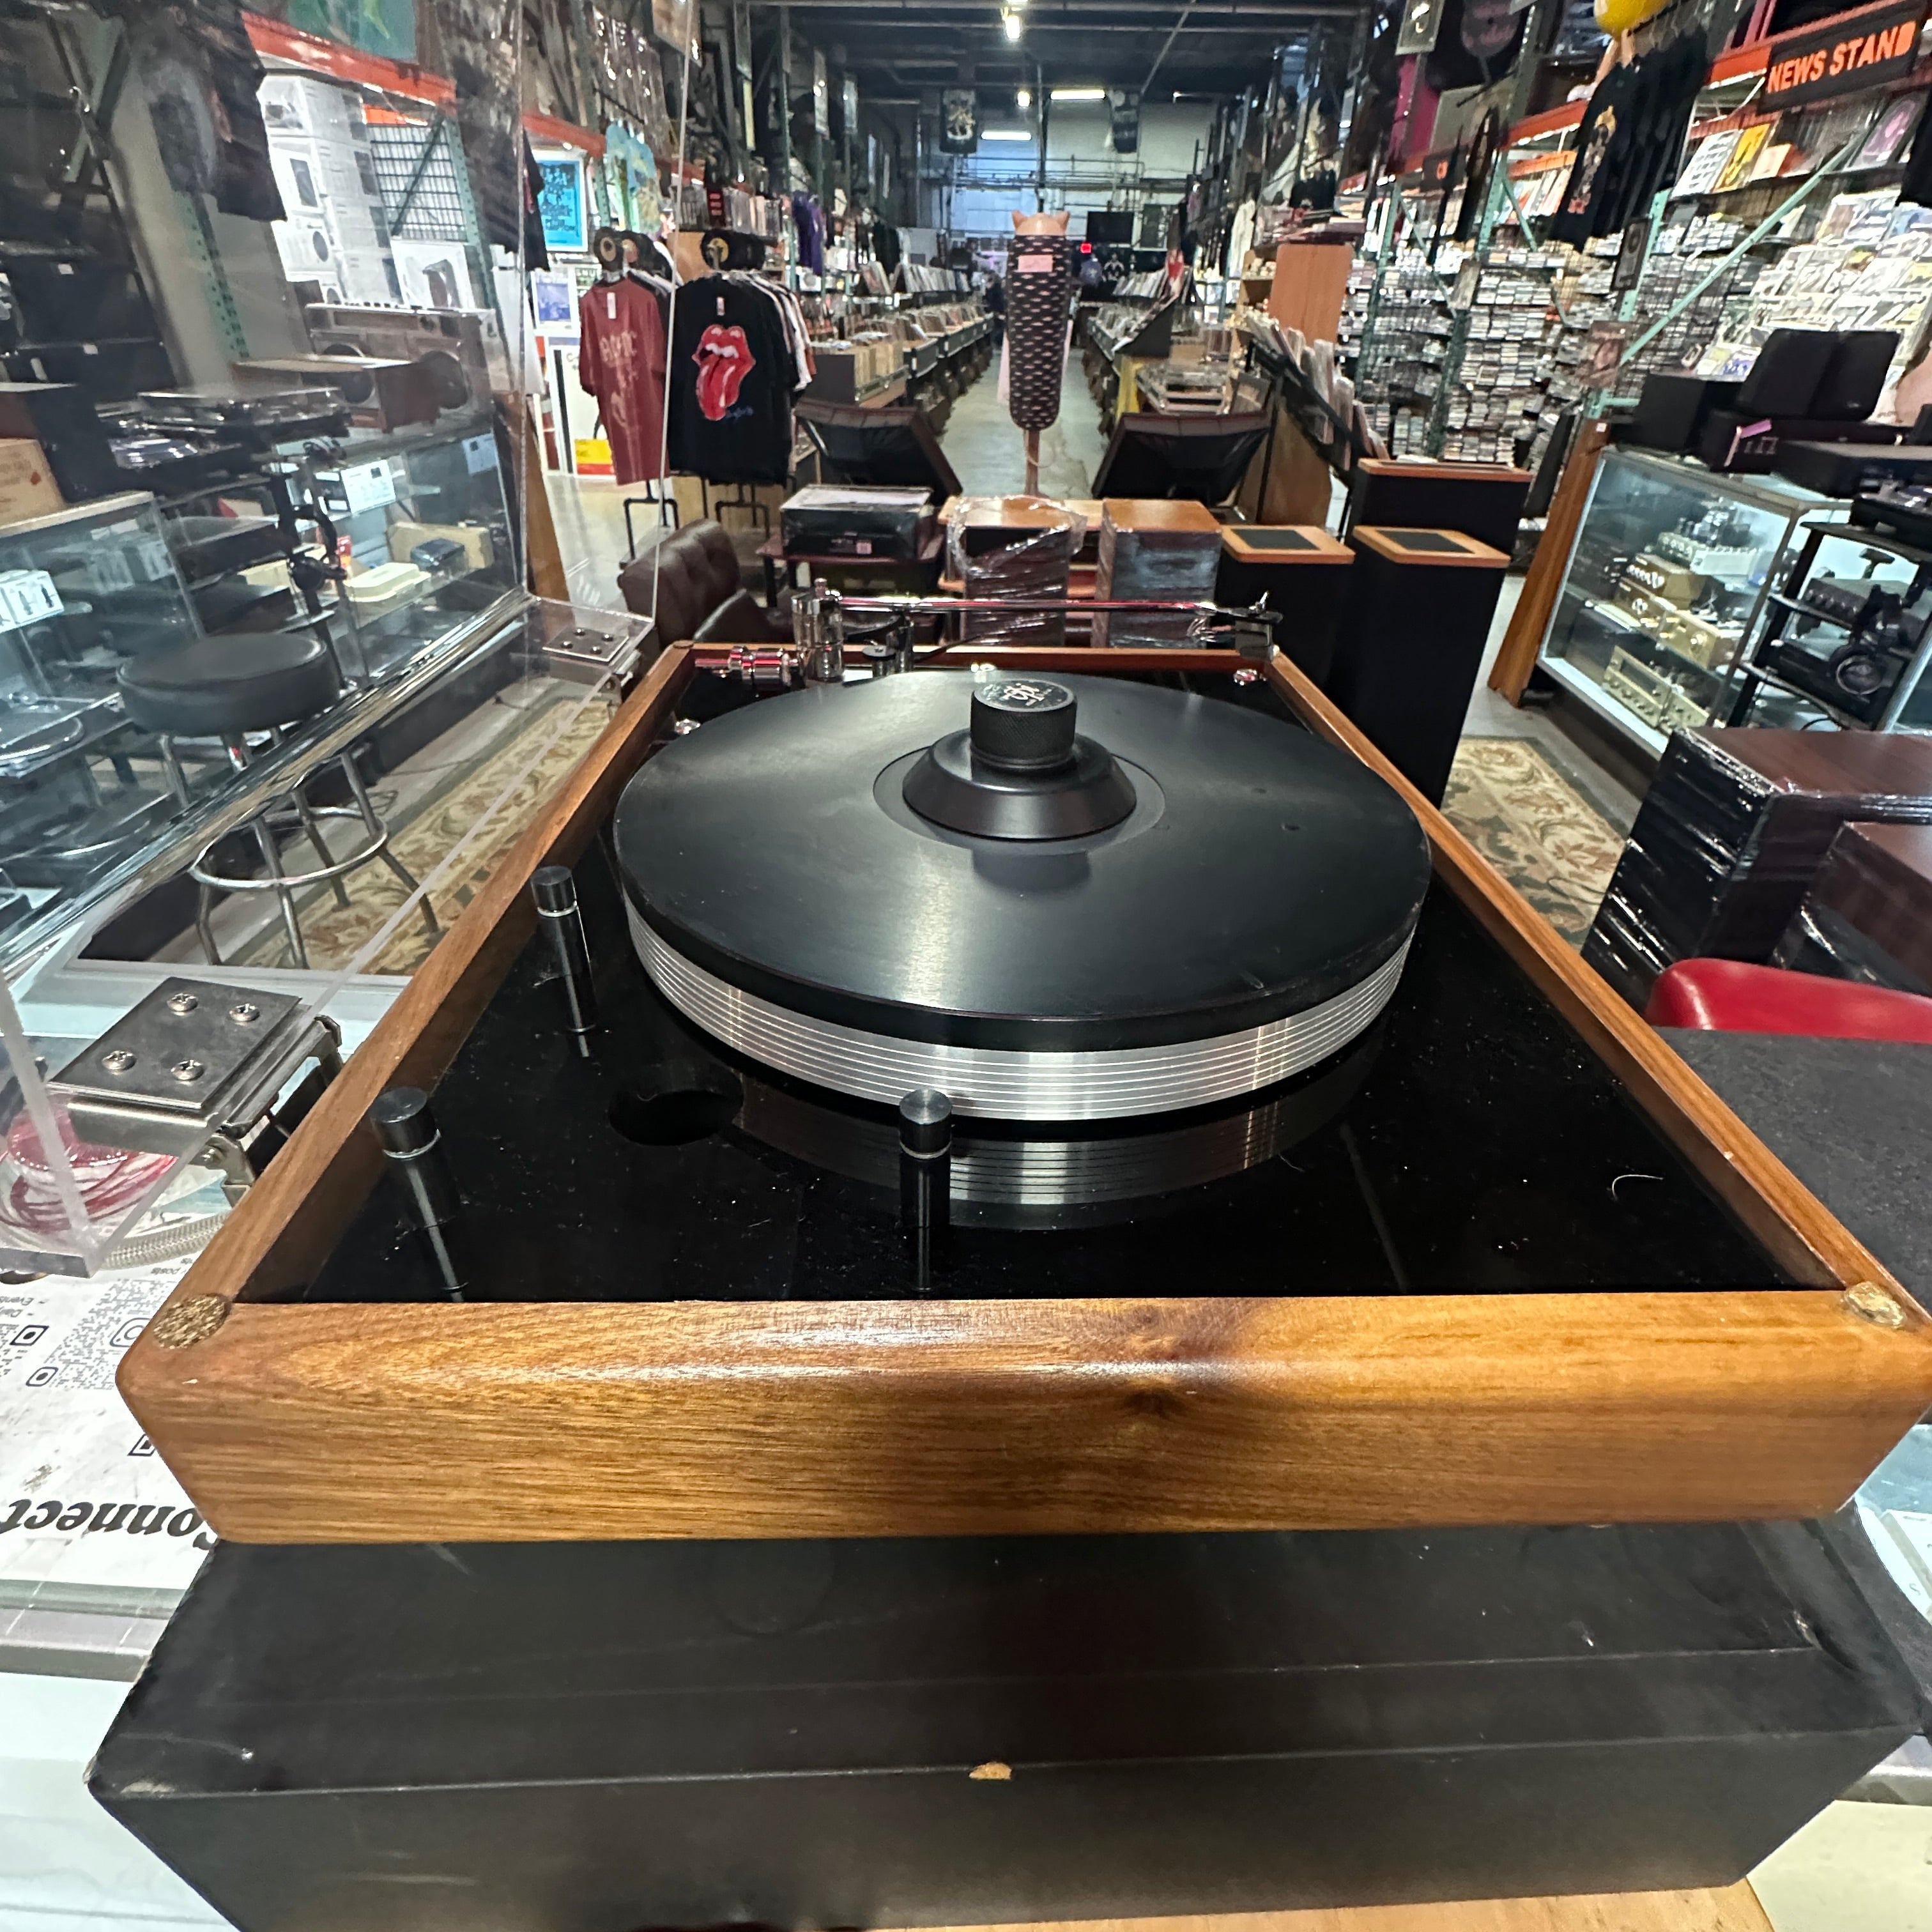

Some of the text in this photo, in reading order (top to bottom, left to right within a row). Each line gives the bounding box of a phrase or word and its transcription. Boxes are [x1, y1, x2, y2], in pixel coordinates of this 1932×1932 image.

[1767, 20, 1917, 94] NEWS STAND
[0, 1499, 218, 1551] onnect
